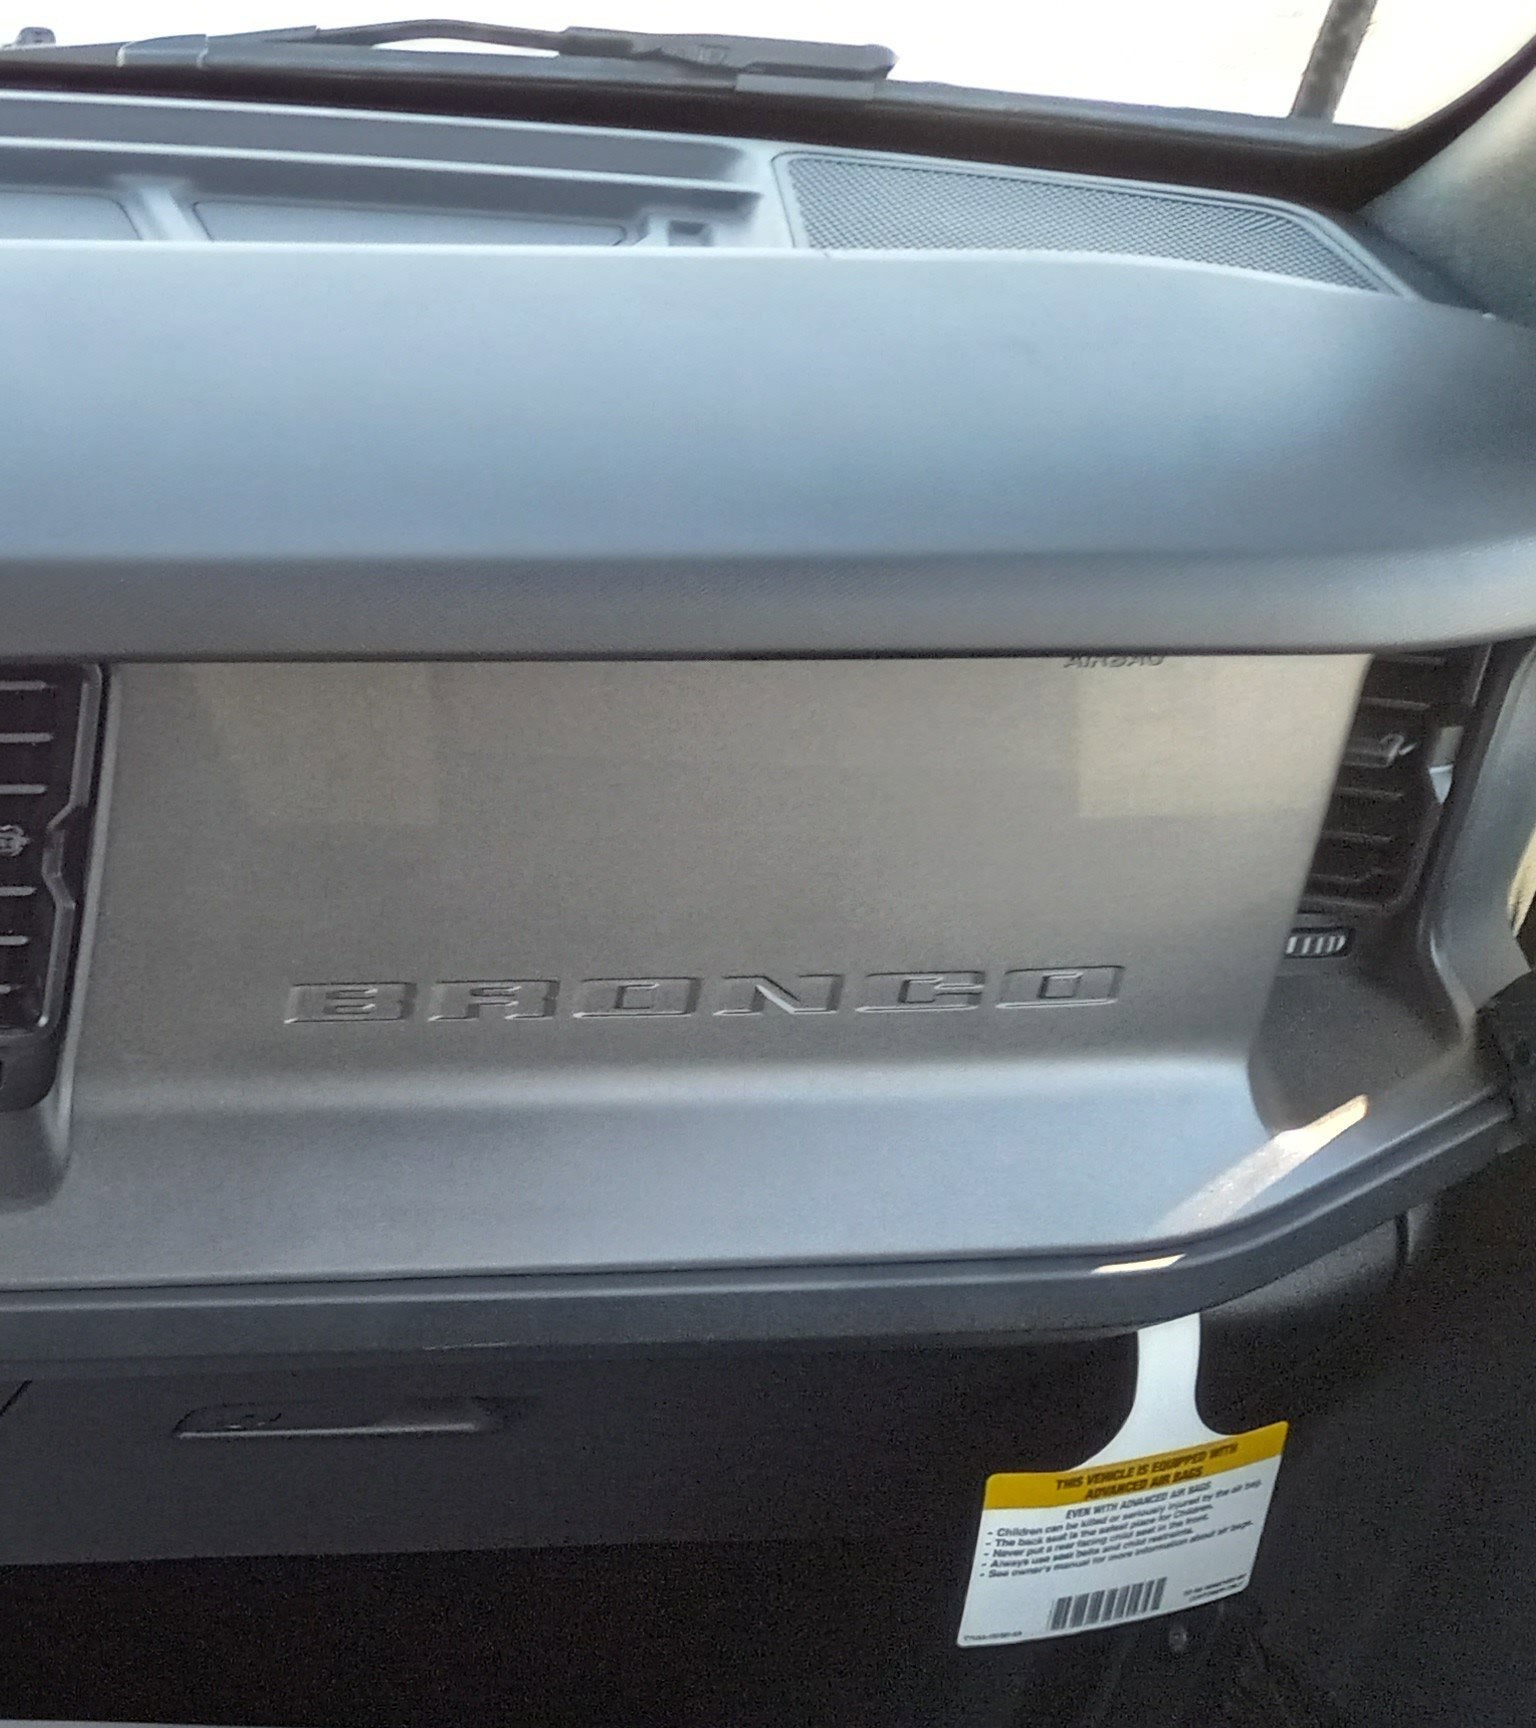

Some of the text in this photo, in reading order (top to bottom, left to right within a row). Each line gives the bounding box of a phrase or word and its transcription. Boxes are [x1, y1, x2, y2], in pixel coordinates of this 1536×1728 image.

[284, 963, 1126, 1025] BRONCO
[1056, 1476, 1083, 1491] THIS
[1086, 1467, 1136, 1486] VEHICLE
[1136, 1464, 1150, 1476] IS
[1085, 1466, 1203, 1501] ADVANCED AIR BAGS
[1066, 1507, 1090, 1519] EVEN
[1094, 1502, 1118, 1514] WITH
[1169, 1487, 1186, 1499] AIR
[995, 1538, 1016, 1547] The
[997, 1527, 1043, 1538] Children
[1045, 1524, 1064, 1533] can
